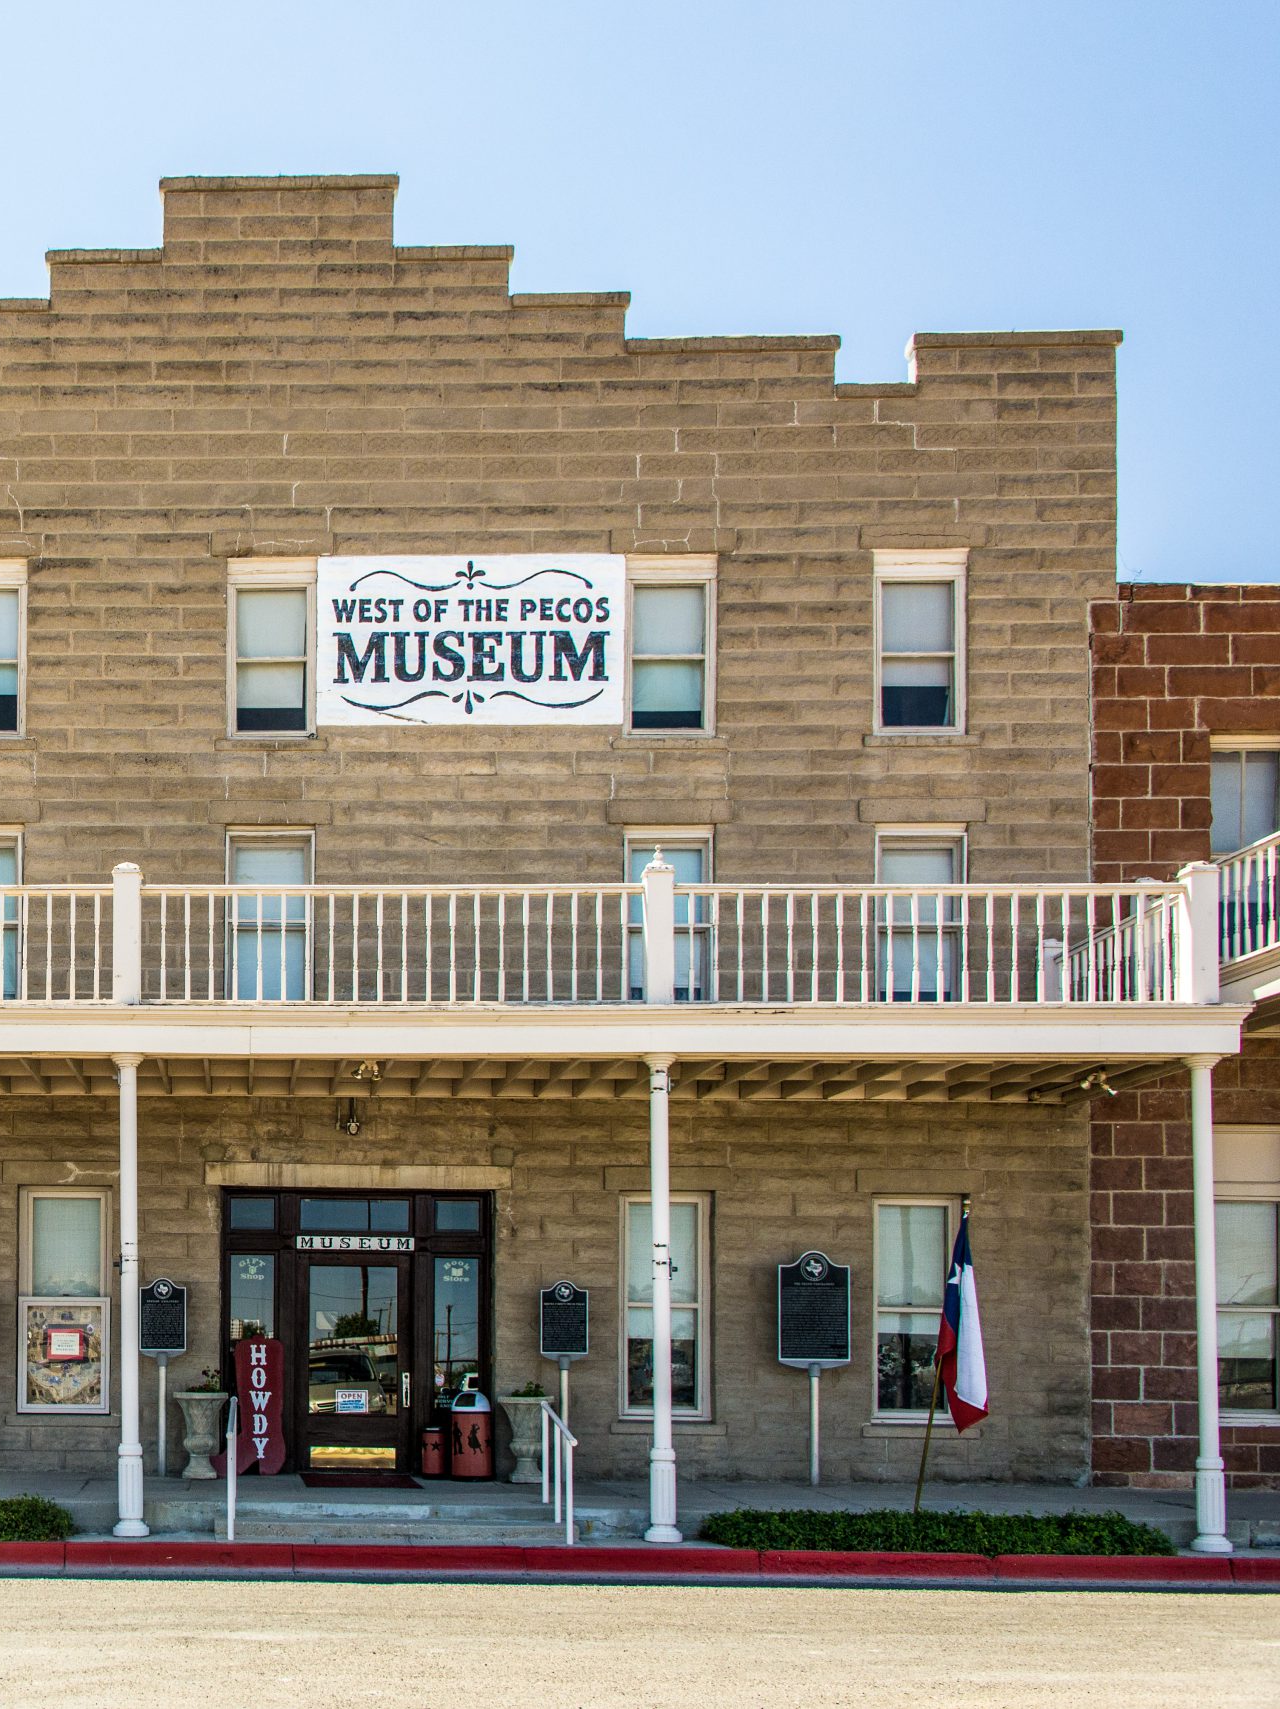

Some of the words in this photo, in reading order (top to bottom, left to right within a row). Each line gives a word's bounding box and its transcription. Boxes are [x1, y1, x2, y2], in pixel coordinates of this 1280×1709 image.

[332, 598, 404, 623] WEST
[412, 597, 450, 623] OF
[457, 598, 510, 622] THE
[520, 596, 610, 623] PECOS
[332, 630, 611, 684] MUSEUM
[300, 1236, 411, 1250] MUSEUM
[249, 1344, 272, 1459] HOWDY
[340, 1392, 363, 1400] OPEN
